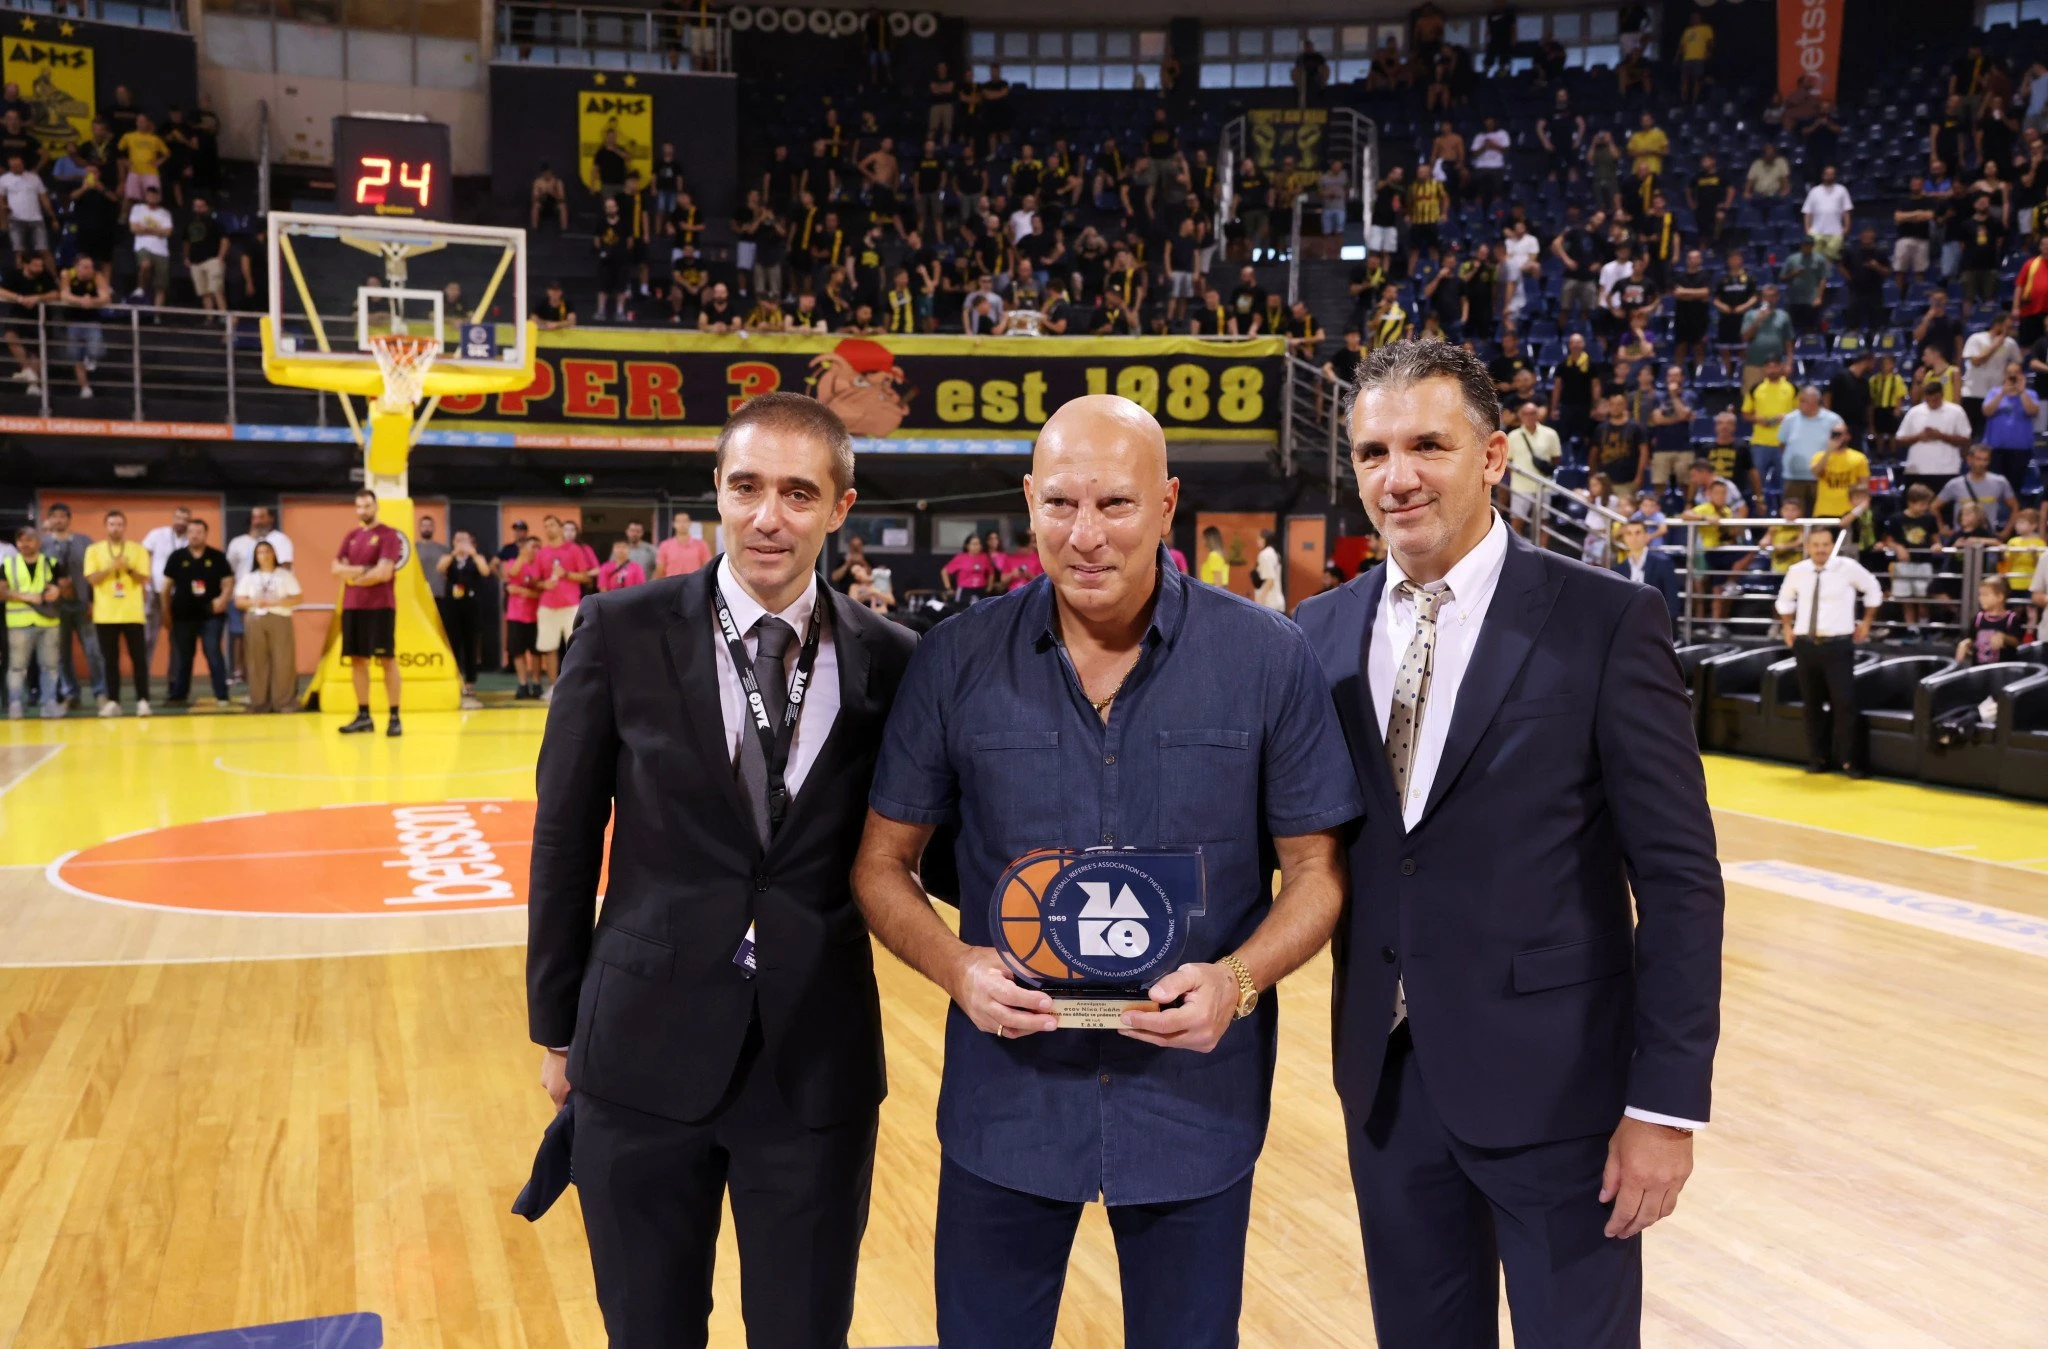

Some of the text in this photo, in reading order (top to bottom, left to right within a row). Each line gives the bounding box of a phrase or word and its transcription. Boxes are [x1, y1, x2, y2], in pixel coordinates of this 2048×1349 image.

[356, 157, 431, 207] 24
[936, 363, 1264, 423] est 1988
[382, 804, 515, 905] betsson
[1050, 861, 1173, 915] BASKETBALL REFEREE'S ASSOCIATION OF THESSALONIKI
